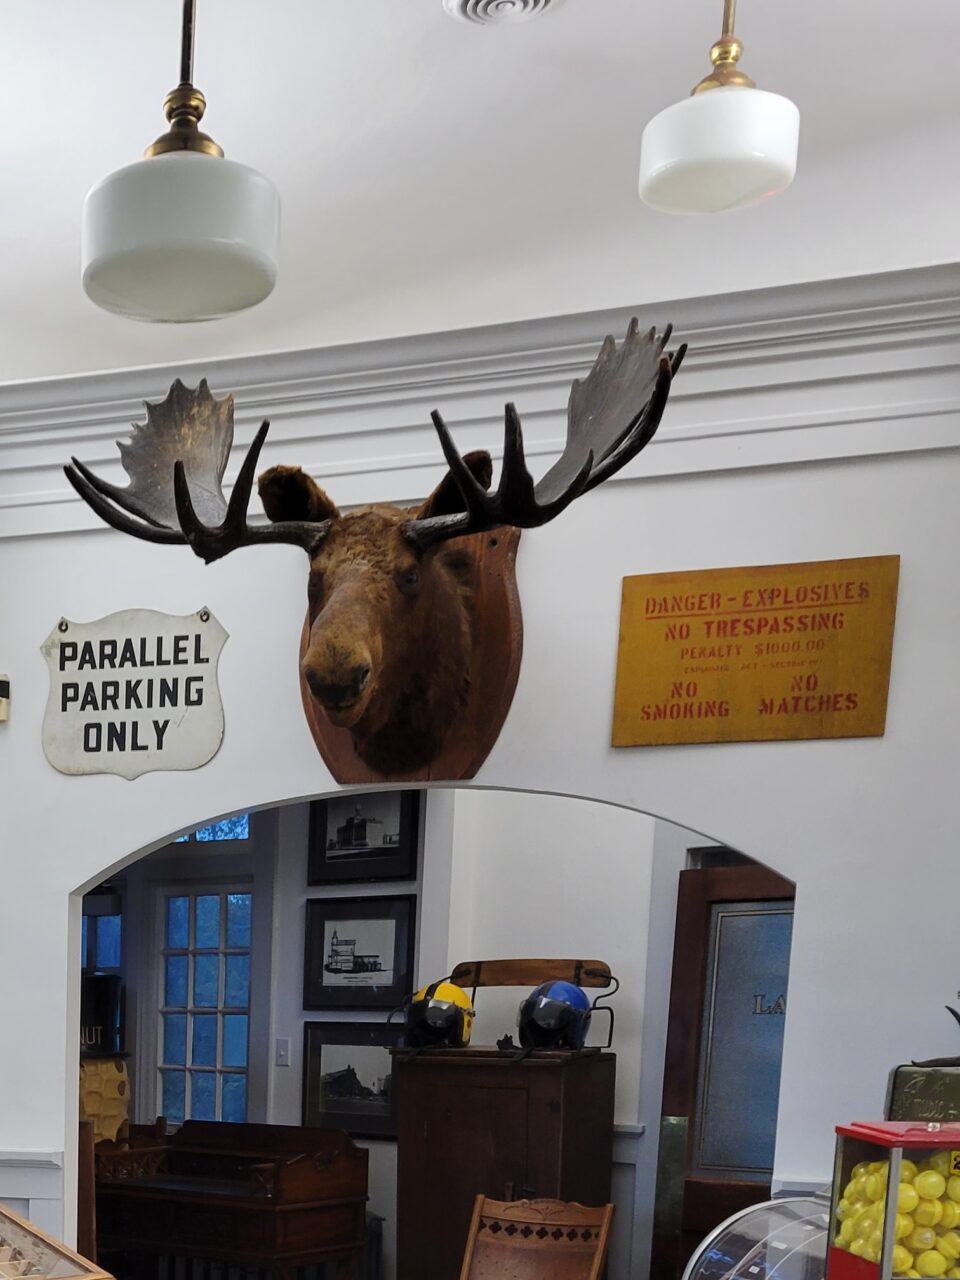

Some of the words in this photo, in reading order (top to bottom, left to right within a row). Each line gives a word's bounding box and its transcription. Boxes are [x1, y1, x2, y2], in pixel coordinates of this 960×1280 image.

[645, 591, 722, 615] DANGER
[742, 581, 871, 609] EXPLOSIVES
[664, 623, 690, 642] NO
[704, 612, 845, 639] TRESPASSING
[59, 634, 210, 671] PARALLEL
[680, 643, 743, 660] PENALTY
[61, 676, 204, 712] PARKING
[671, 681, 698, 700] NO
[790, 673, 819, 693] NO
[640, 700, 730, 721] SMOKING
[758, 692, 859, 715] MATCHES
[83, 719, 171, 752] ONLY
